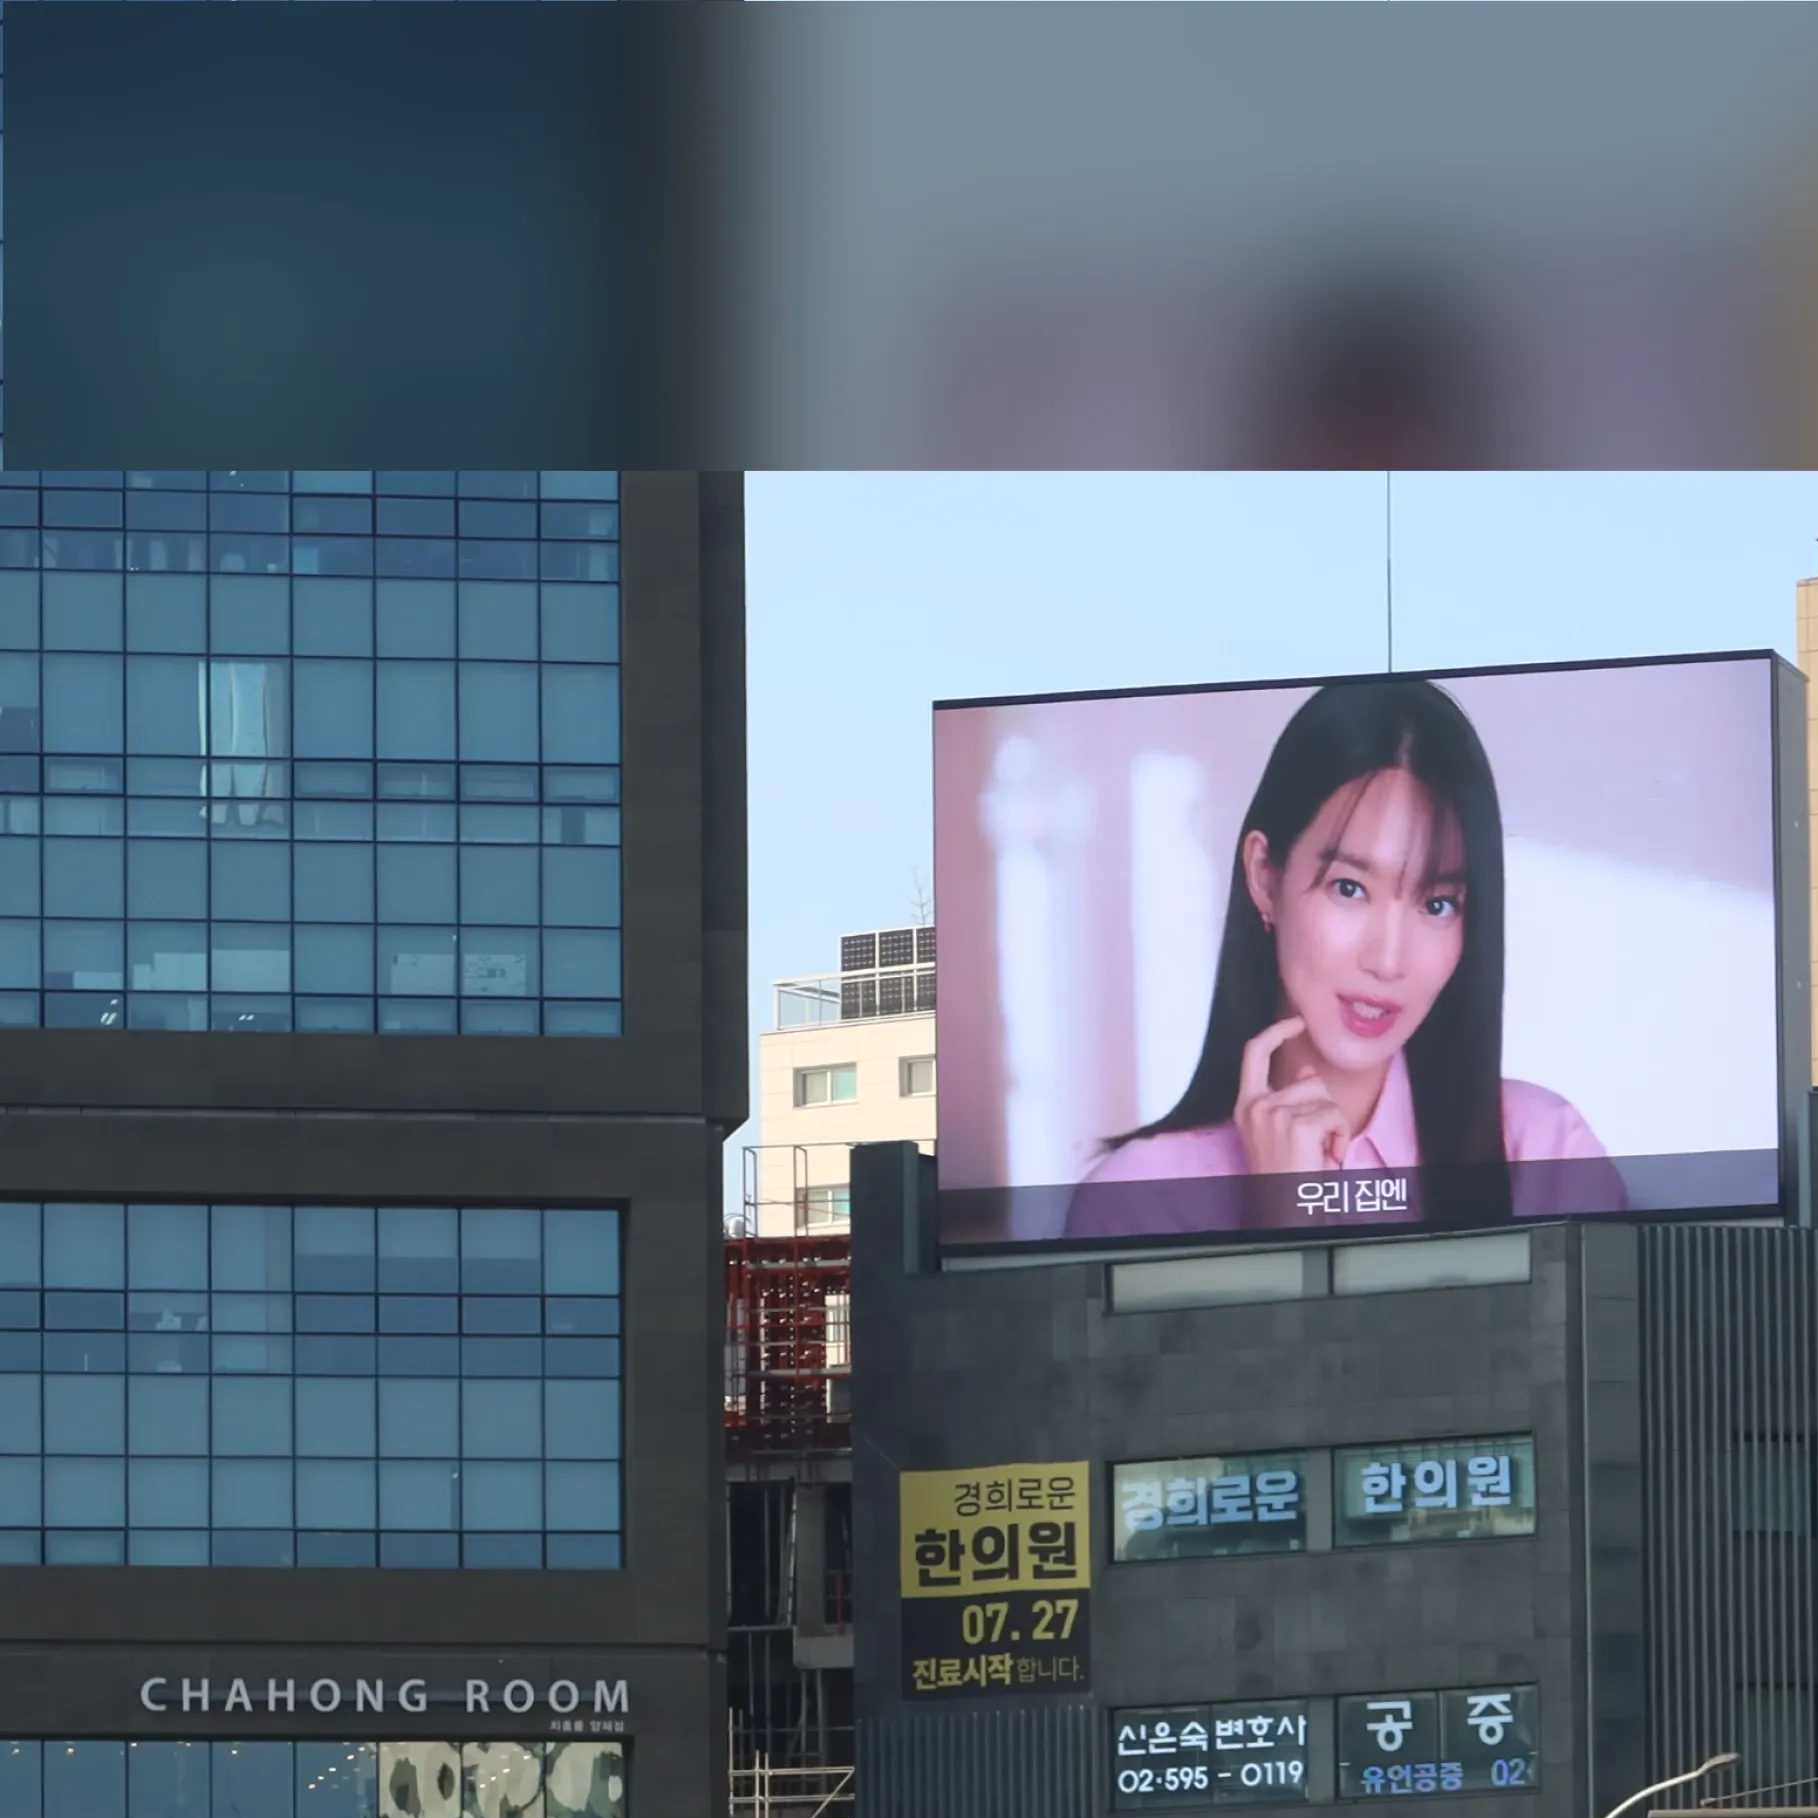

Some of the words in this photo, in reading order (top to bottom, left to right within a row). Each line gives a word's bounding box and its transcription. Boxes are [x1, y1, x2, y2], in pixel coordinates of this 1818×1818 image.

[1297, 1181, 1349, 1215] 우리
[1354, 1178, 1408, 1212] 집엔
[954, 1476, 1076, 1517] 경희로운
[1120, 1470, 1299, 1532] 경희로운
[1361, 1455, 1512, 1515] 한의원
[914, 1521, 1077, 1588] 한의원
[140, 1677, 427, 1713] CHAHONG
[465, 1679, 629, 1713] ROOM
